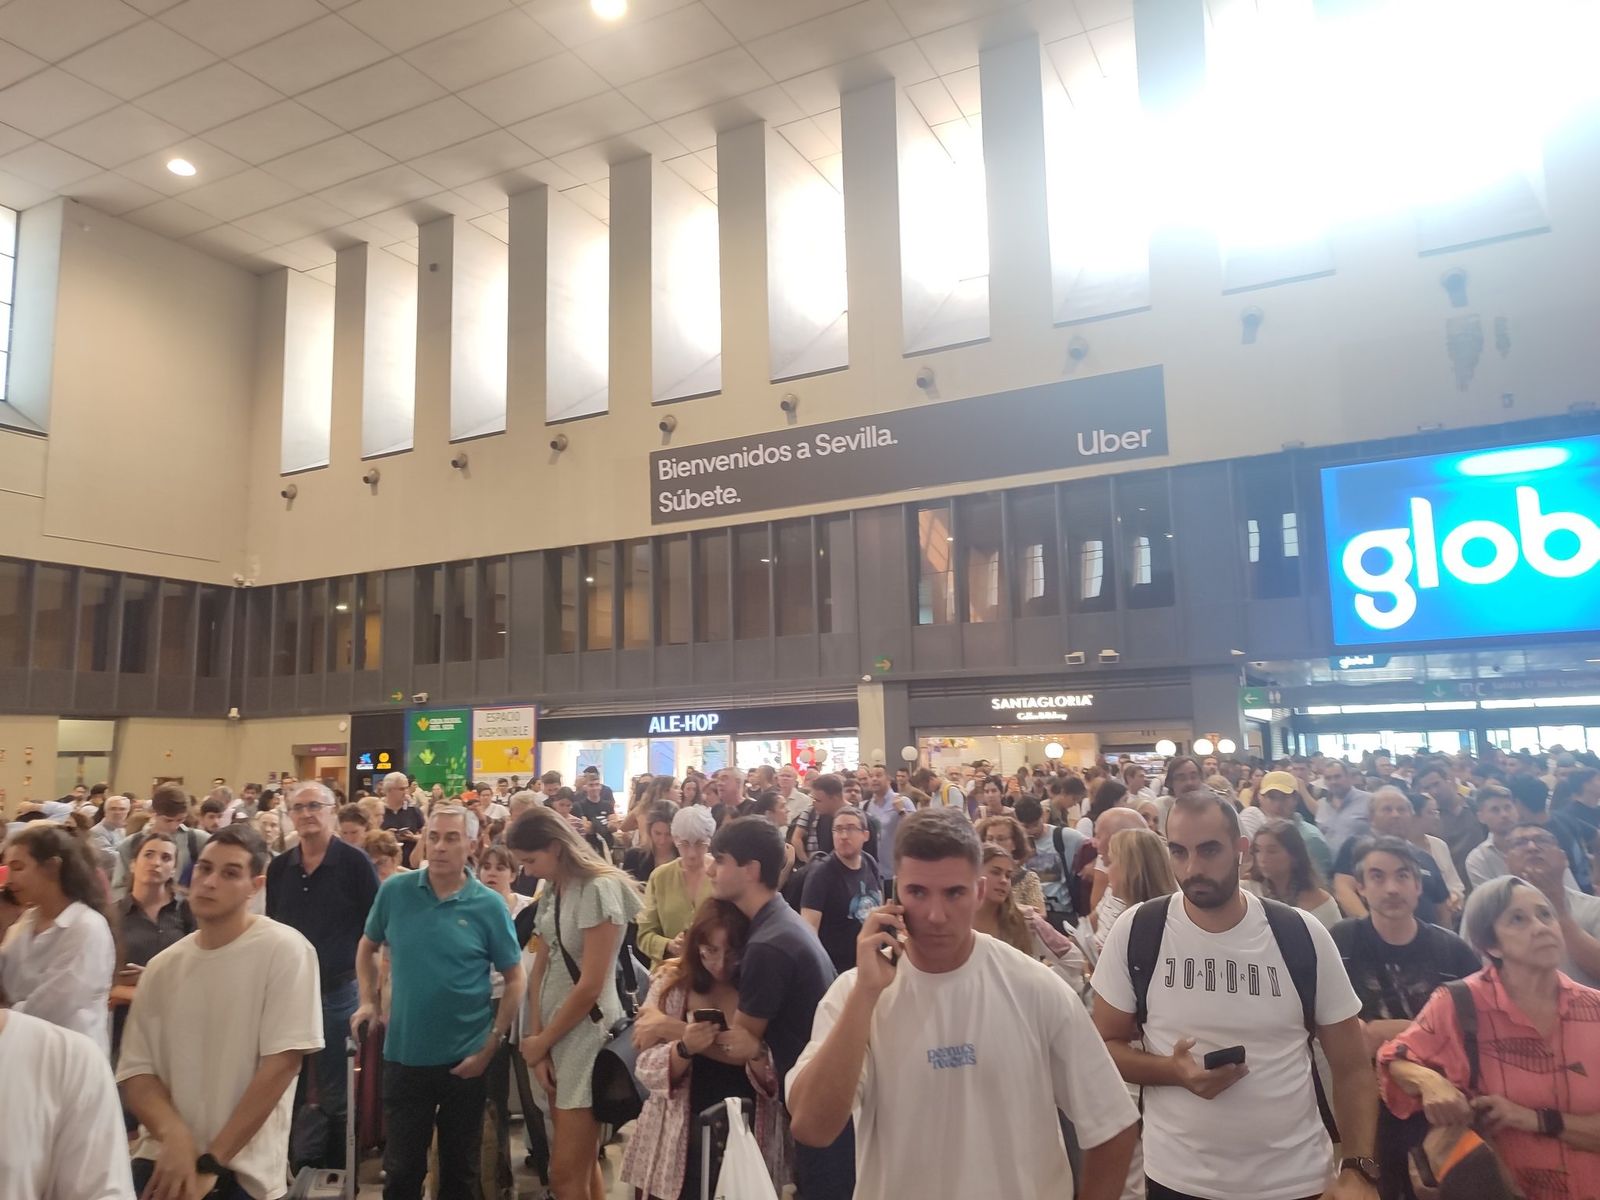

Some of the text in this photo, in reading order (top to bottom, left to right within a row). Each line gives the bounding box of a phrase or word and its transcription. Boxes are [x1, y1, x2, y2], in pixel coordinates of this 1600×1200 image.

[657, 425, 898, 481] Bienvenidos a Sevilla.
[1077, 427, 1152, 457] Uber
[658, 485, 741, 513] Súbete.
[991, 695, 1093, 709] SANTAGLORIA
[486, 711, 520, 722] ESPACIO
[648, 713, 719, 733] ALE-HOP
[478, 726, 528, 737] DISPONIBLE
[1165, 958, 1281, 997] JORDAN
